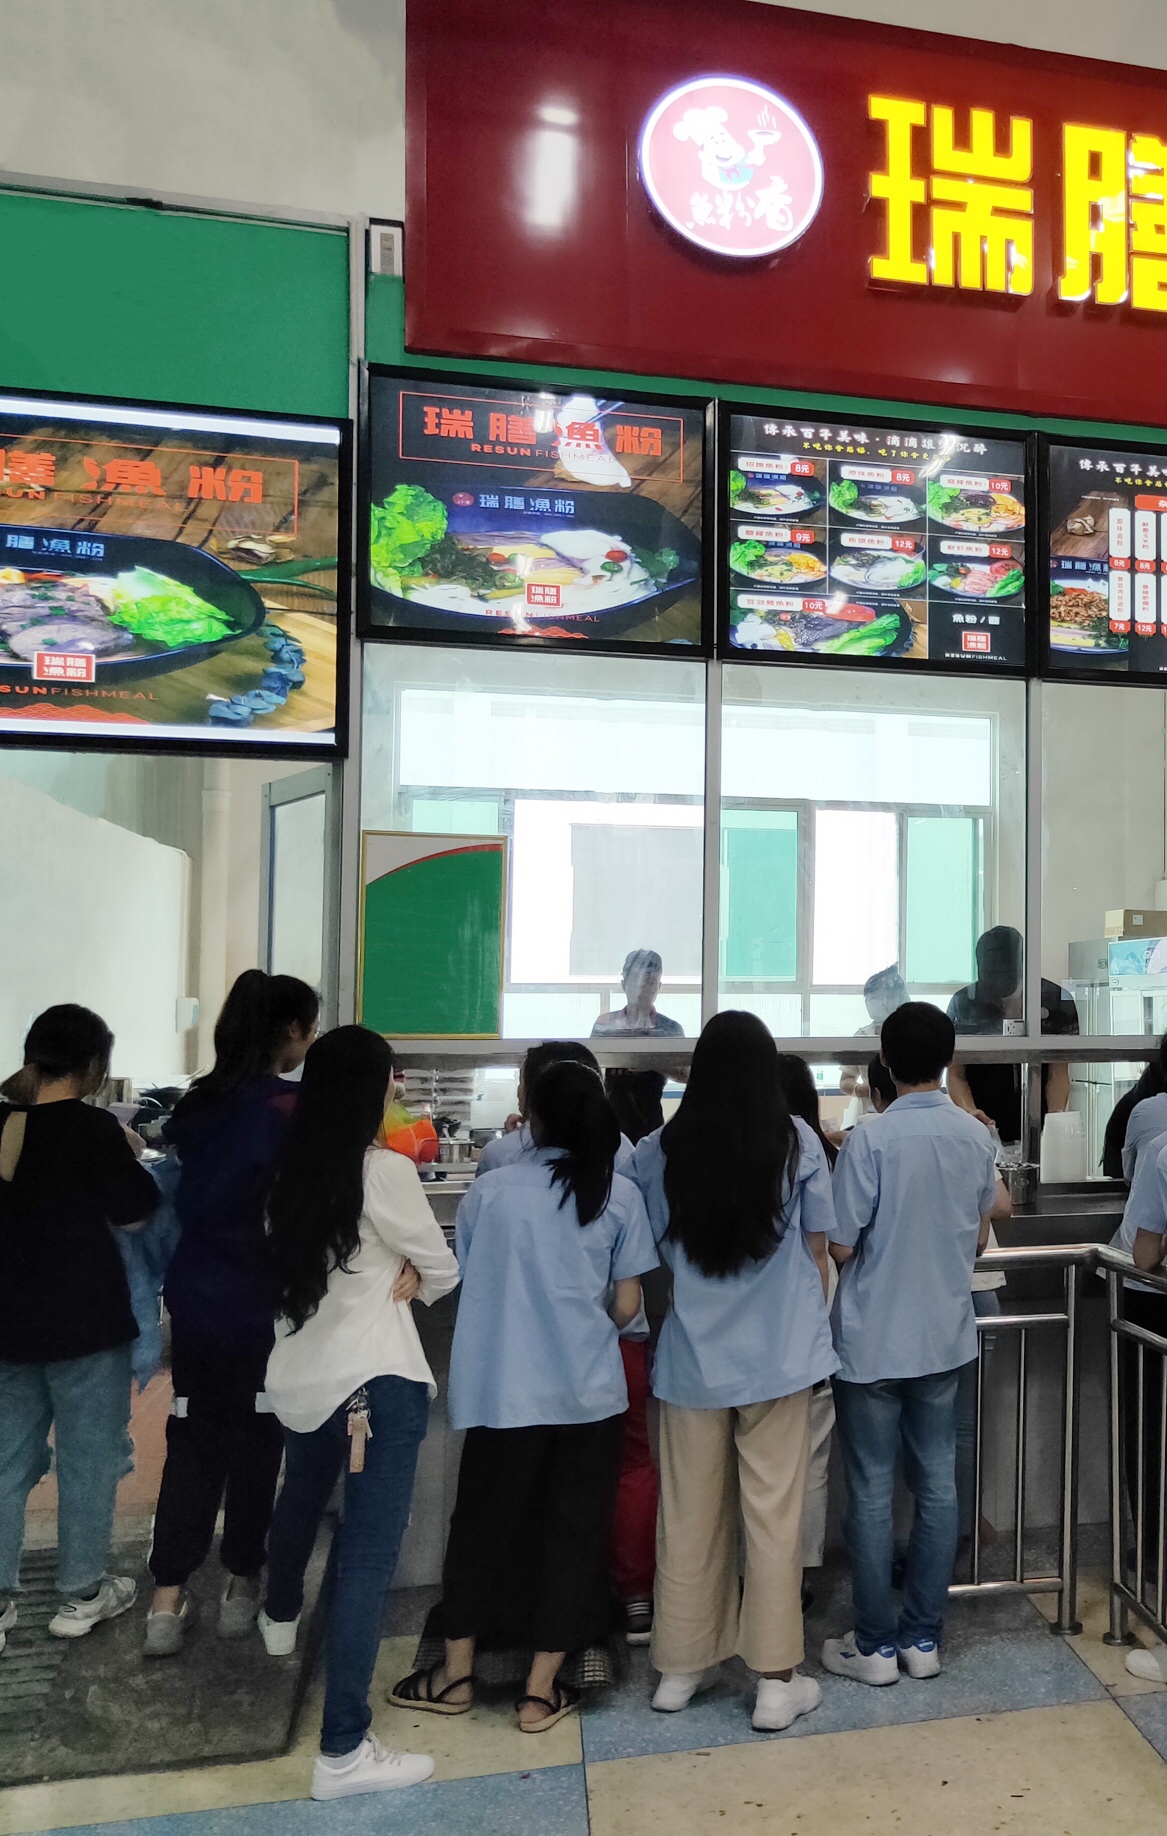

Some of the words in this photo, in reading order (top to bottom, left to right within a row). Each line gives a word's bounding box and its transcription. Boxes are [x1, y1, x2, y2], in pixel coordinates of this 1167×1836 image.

[423, 406, 662, 456] 瑞膳漁粉
[470, 443, 531, 457] RESUN
[535, 450, 615, 464] FISHMEAL
[795, 464, 810, 473] 8元
[896, 473, 911, 482] 8元
[990, 482, 1009, 491] 10元
[0, 487, 46, 500] UN
[54, 492, 191, 512] FISHMEAL
[479, 493, 575, 514] 瑞膳漁粉
[795, 533, 811, 542] 9元
[895, 540, 913, 549] 12元
[991, 547, 1009, 556] 12元
[804, 601, 824, 610] 10元
